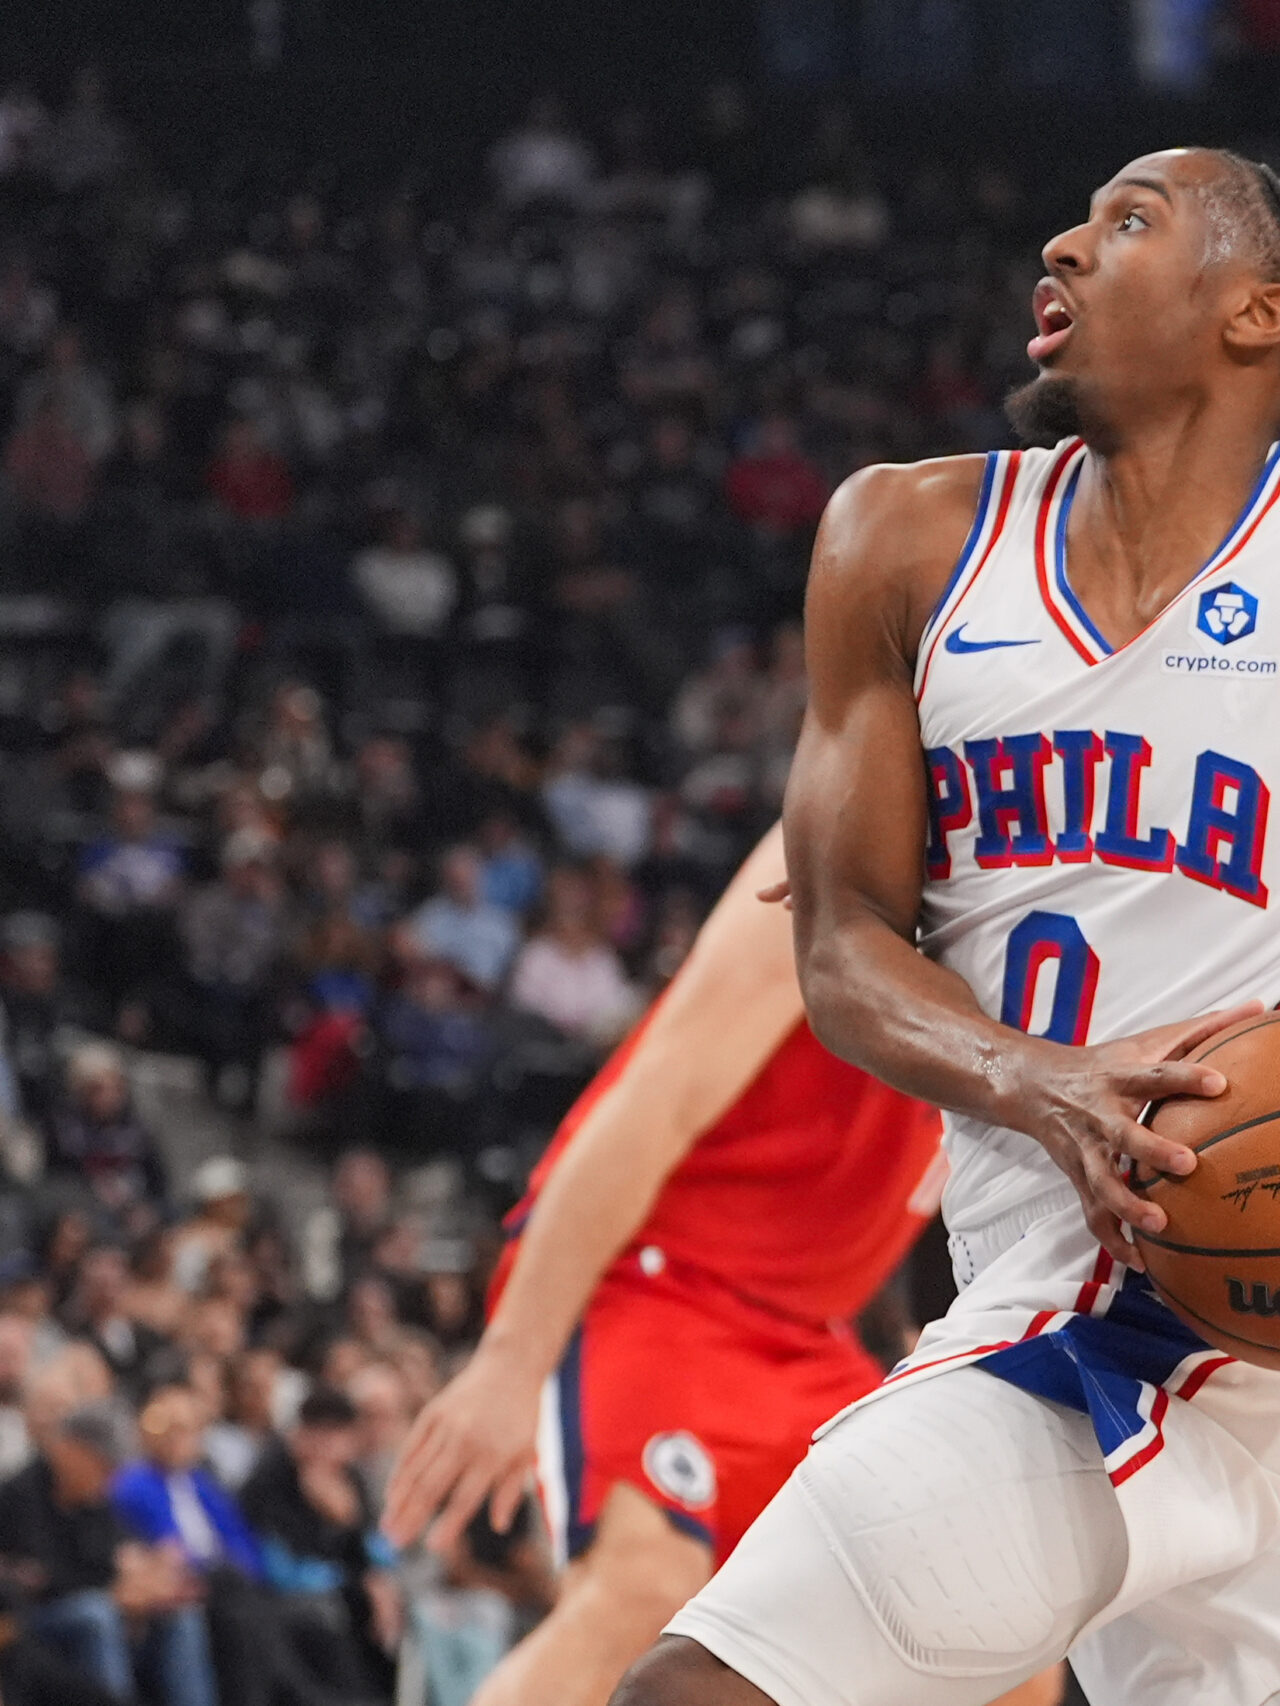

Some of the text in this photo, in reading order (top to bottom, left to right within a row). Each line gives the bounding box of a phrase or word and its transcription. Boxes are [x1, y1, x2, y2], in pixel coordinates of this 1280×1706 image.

[1165, 655, 1277, 673] crypto.com
[923, 729, 1271, 909] PHILA
[1001, 910, 1100, 1046] 0
